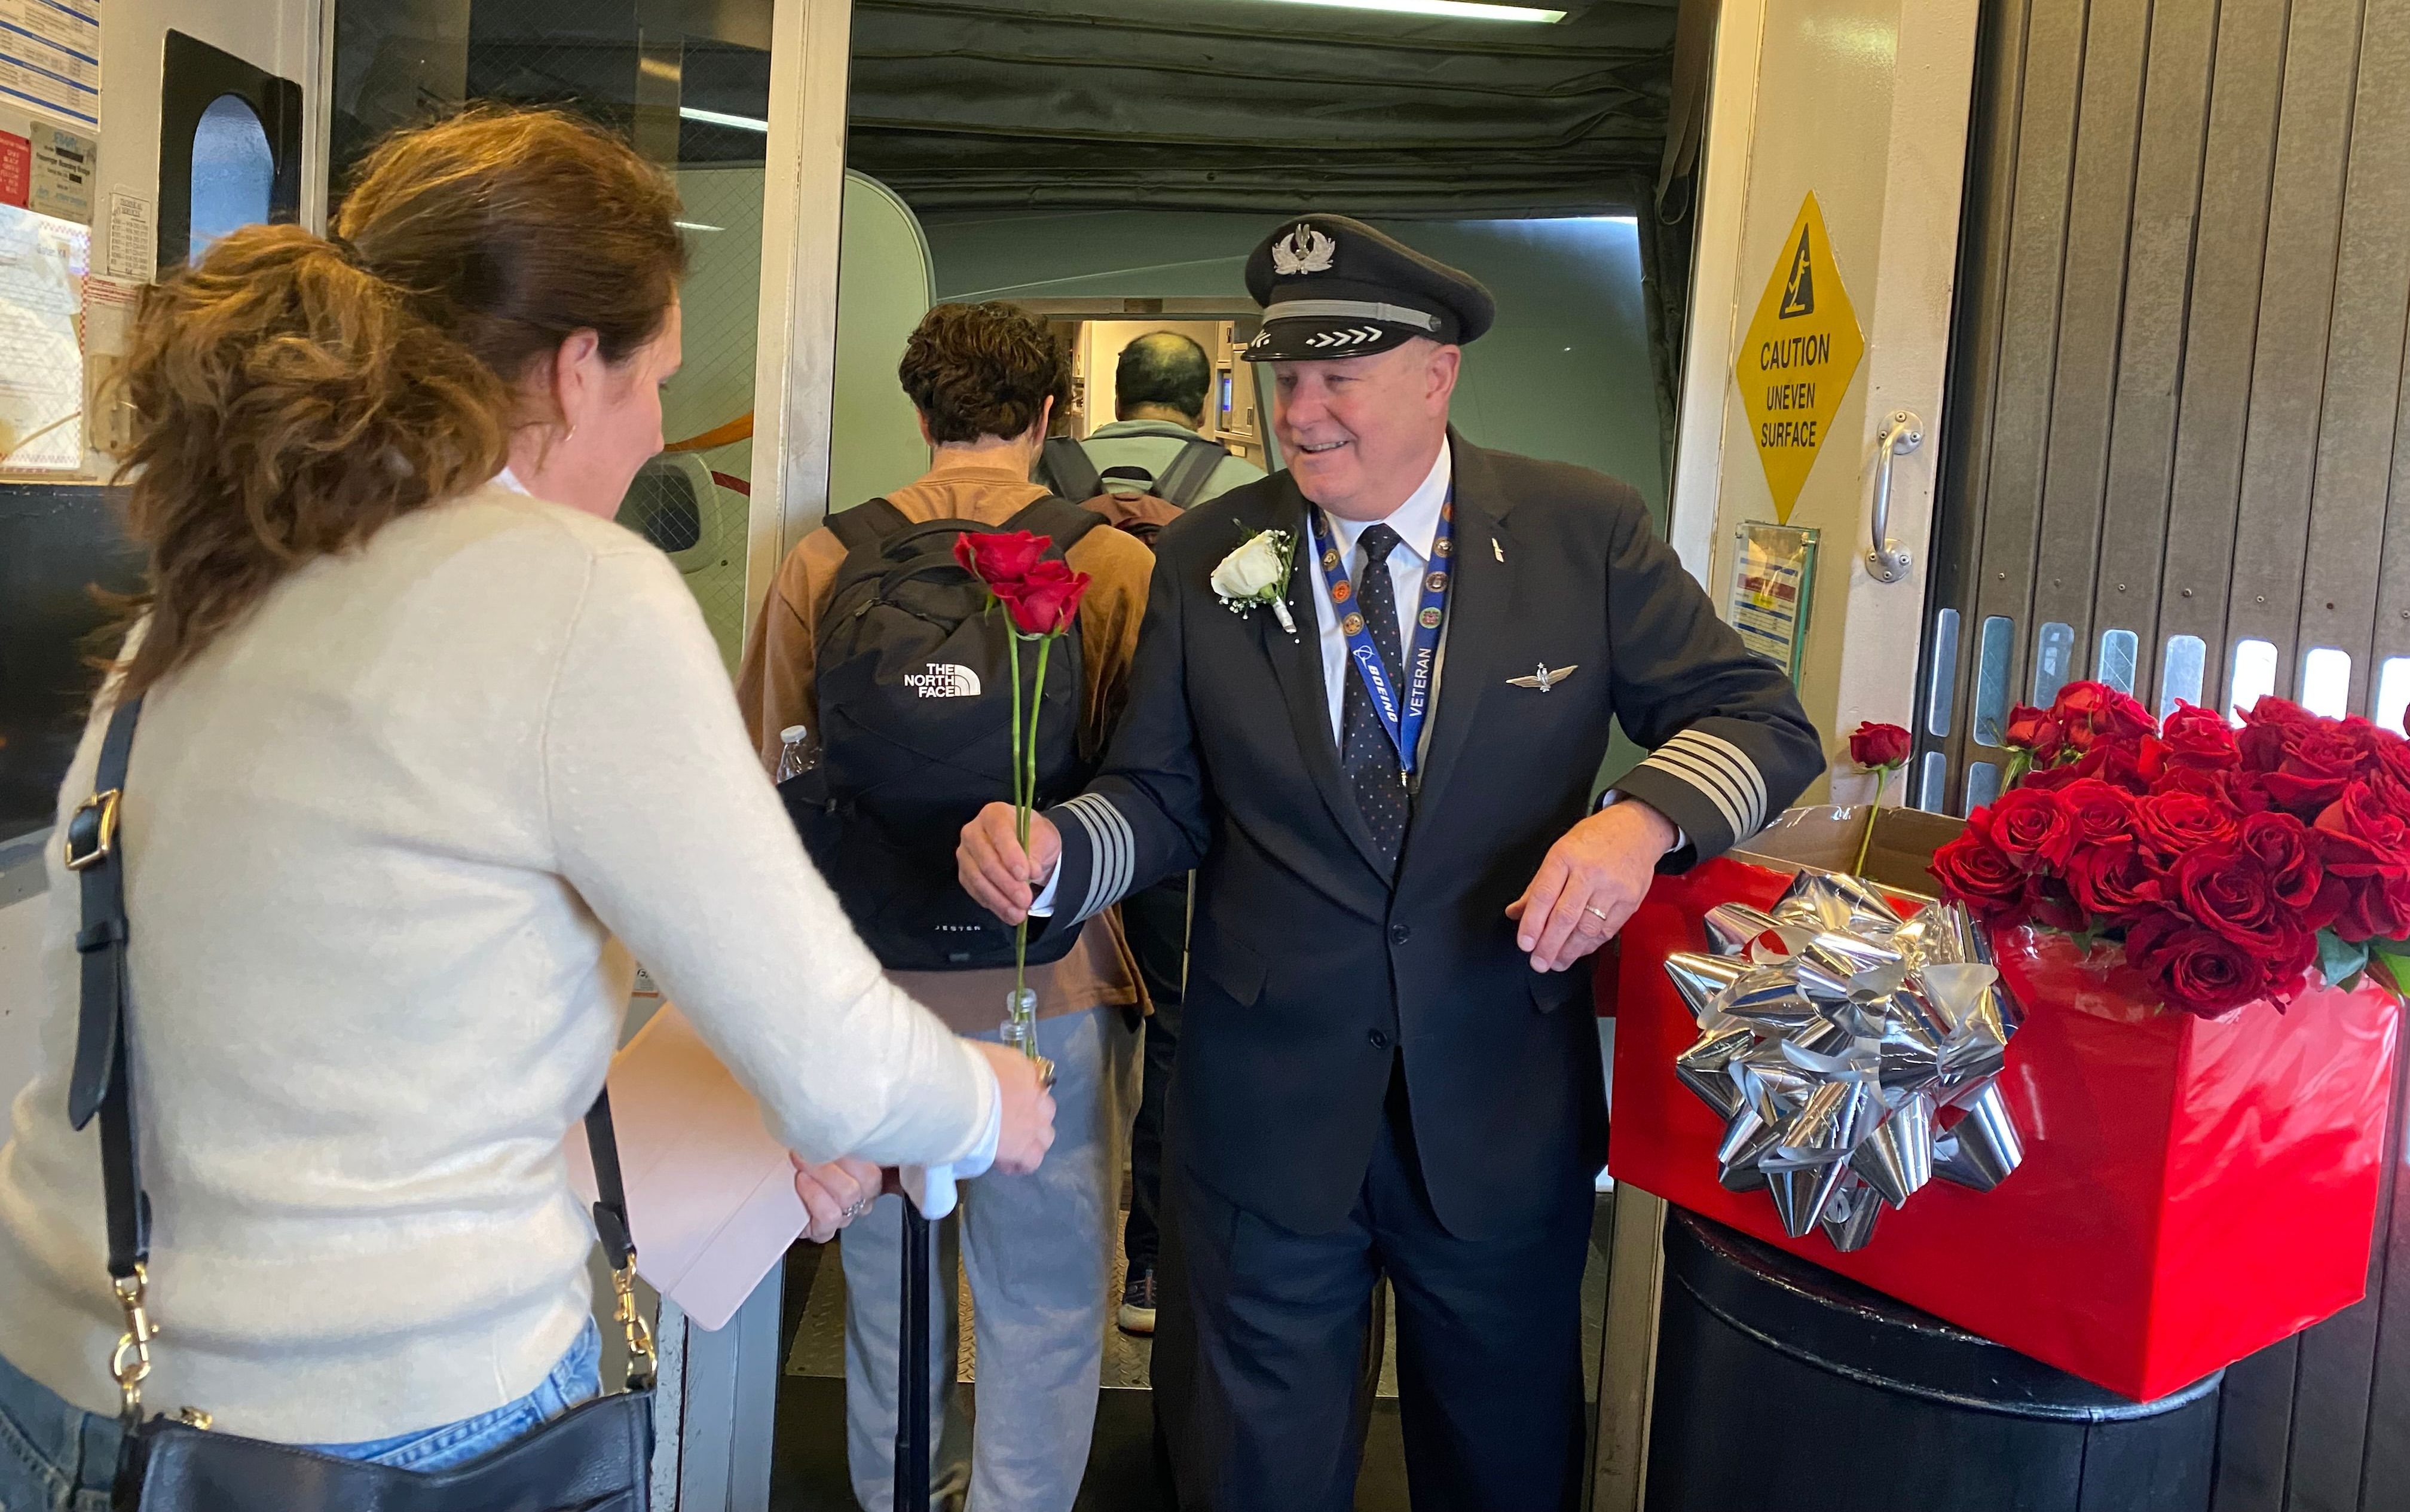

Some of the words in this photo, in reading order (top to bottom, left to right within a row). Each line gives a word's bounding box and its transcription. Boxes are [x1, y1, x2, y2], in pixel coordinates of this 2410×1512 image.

[1761, 333, 1830, 371] CAUTION
[1767, 382, 1815, 411] UNEVEN
[1761, 421, 1817, 448] SURFACE
[904, 674, 955, 686] NORTH
[926, 663, 955, 675] THE
[1409, 648, 1432, 717] VETERAN
[918, 686, 955, 698] FACE
[1367, 665, 1398, 723] BOEING
